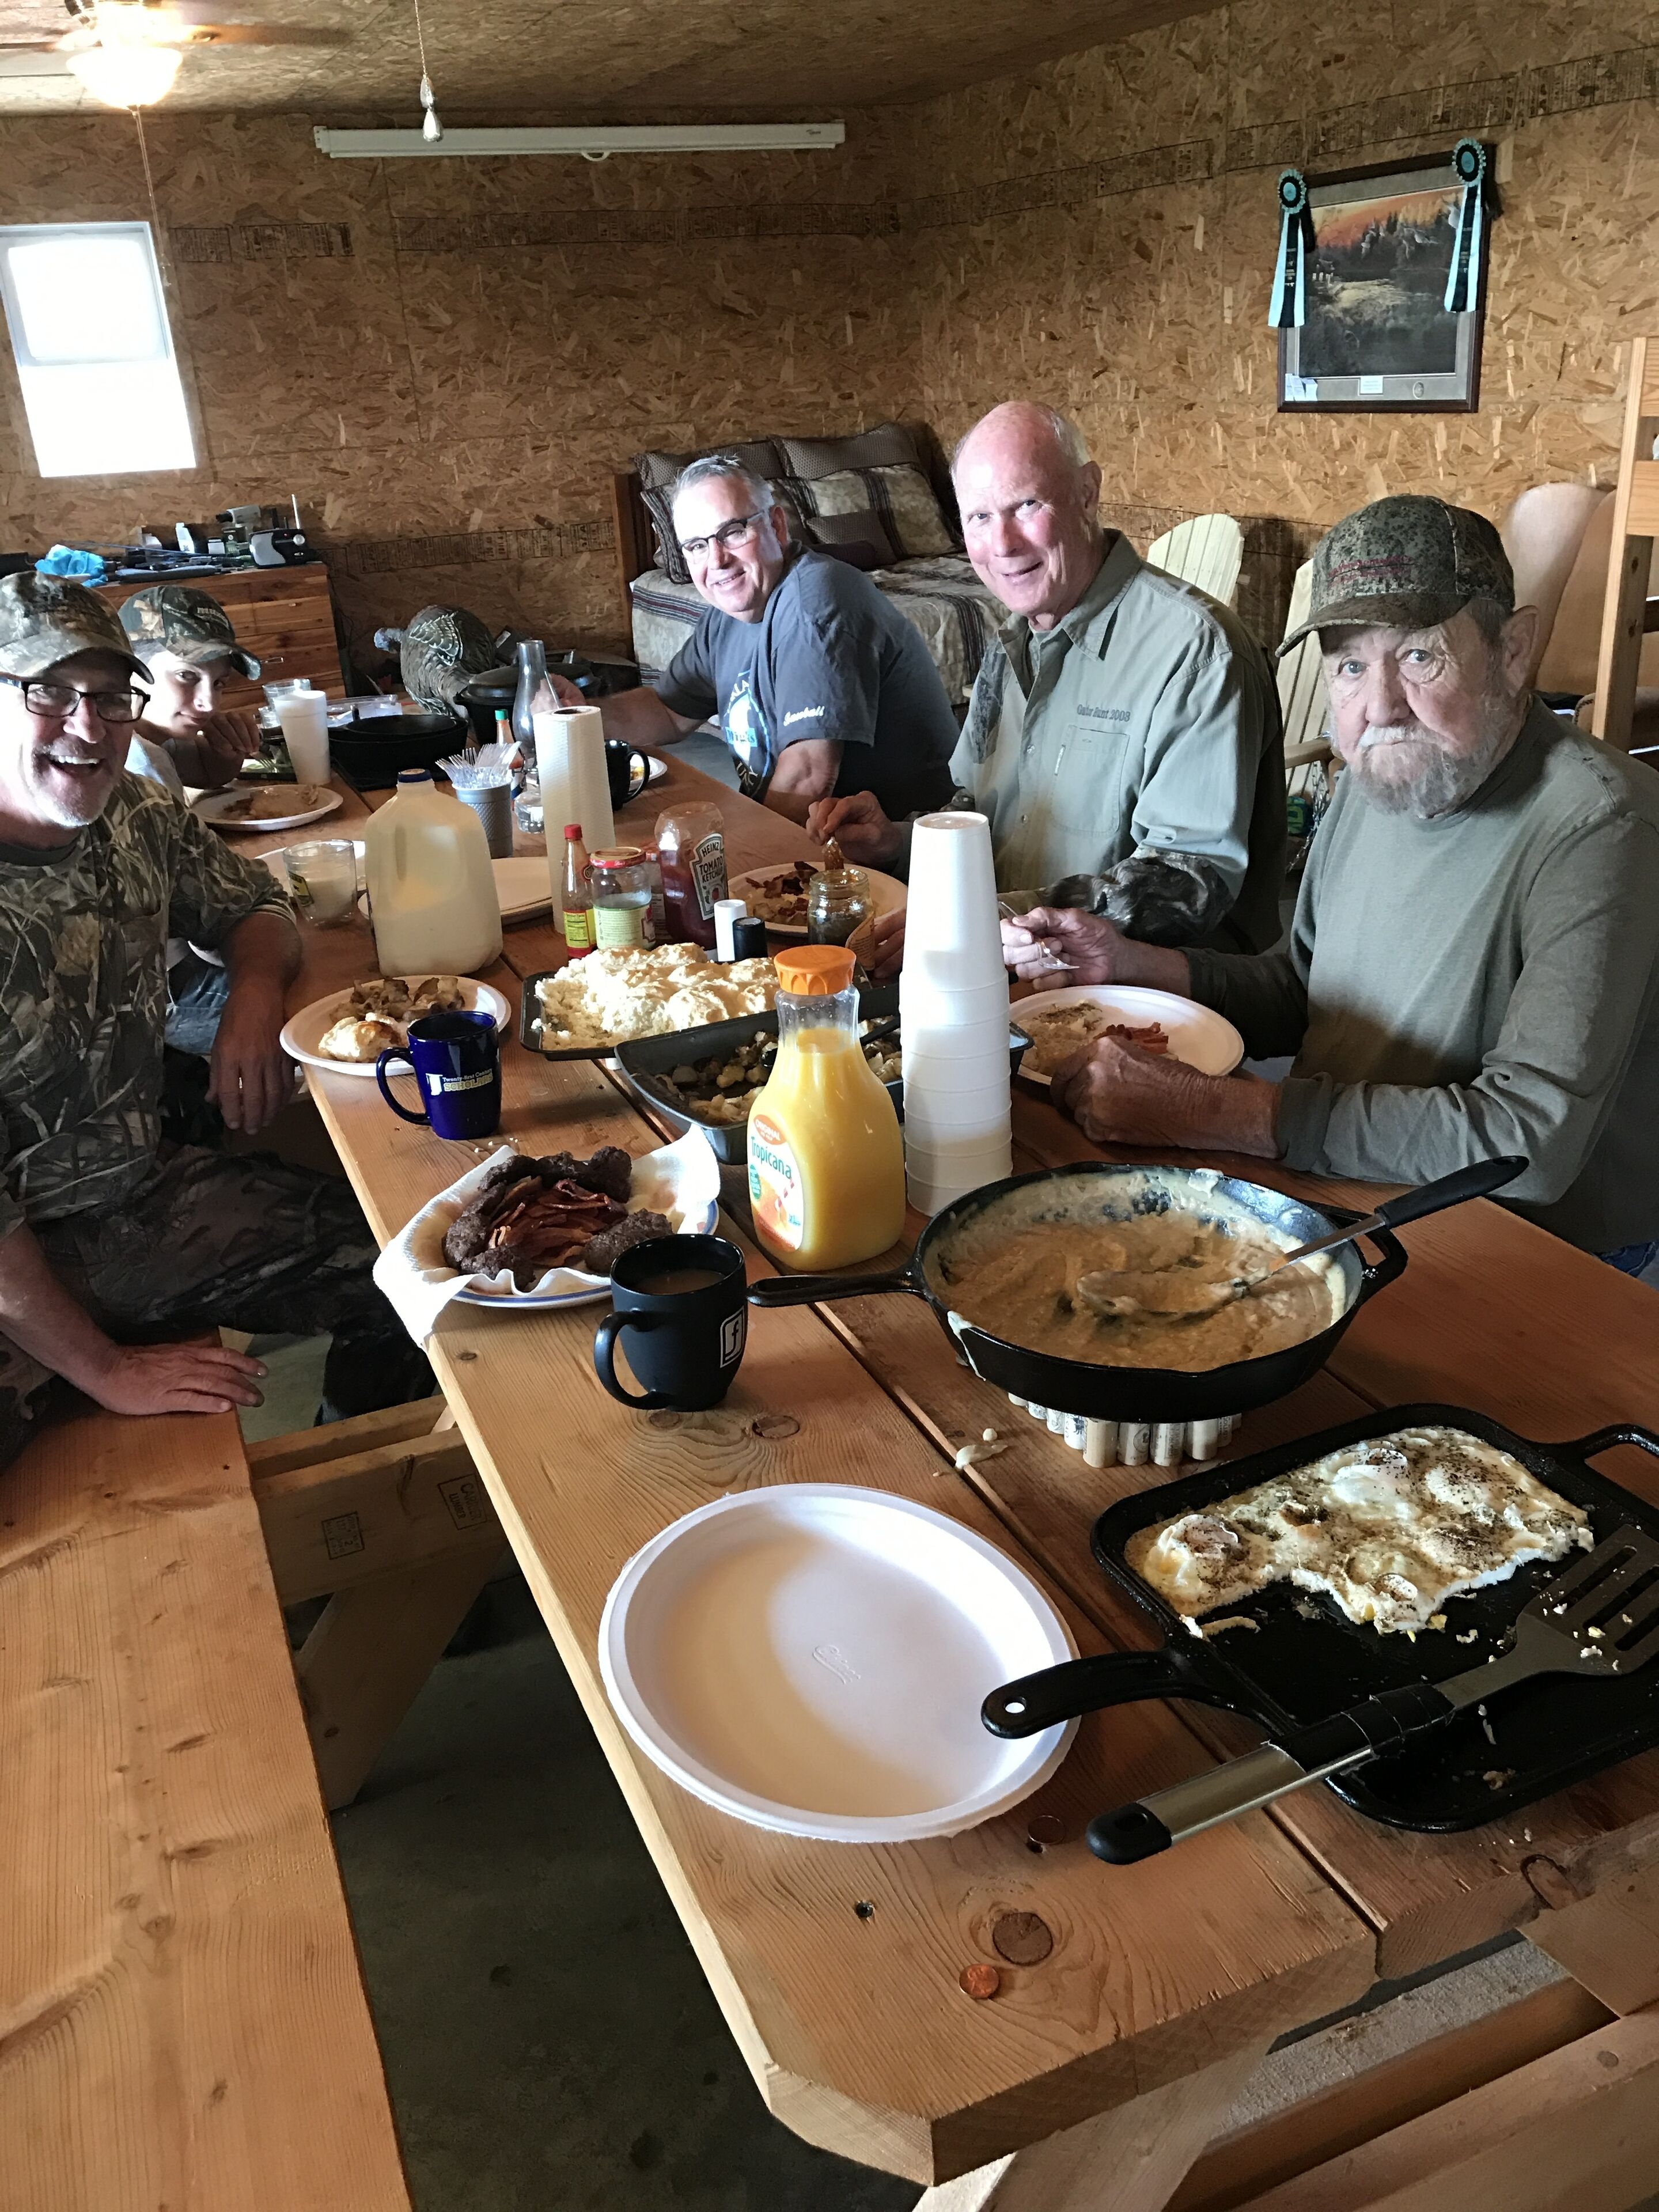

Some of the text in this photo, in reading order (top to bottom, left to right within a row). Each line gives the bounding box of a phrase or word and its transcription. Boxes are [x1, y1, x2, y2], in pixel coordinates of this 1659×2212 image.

[701, 842, 719, 857] HEINZ
[699, 855, 724, 874] TOMATO
[755, 1119, 782, 1141] ORIGINAL
[750, 1136, 792, 1180] Tropicana
